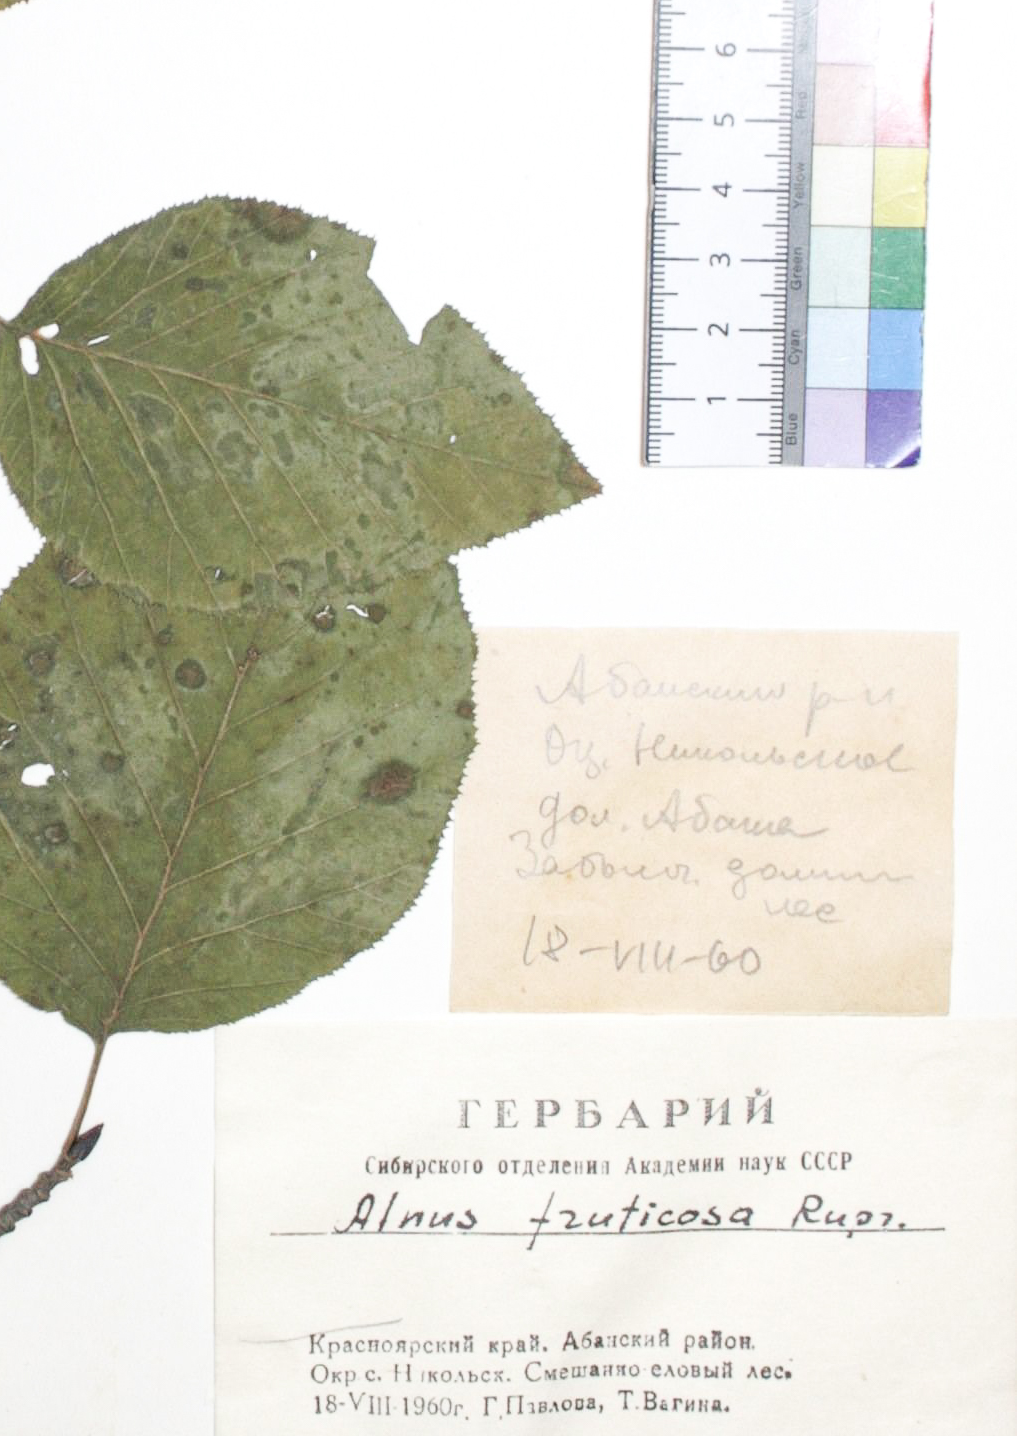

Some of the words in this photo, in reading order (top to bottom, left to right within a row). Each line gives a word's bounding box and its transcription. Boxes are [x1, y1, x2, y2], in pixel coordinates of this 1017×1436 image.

[715, 42, 737, 58] 6
[713, 112, 735, 127] 5
[712, 182, 733, 198] 4
[793, 162, 806, 209] Yellow
[709, 252, 731, 267] 3
[790, 246, 803, 291] Green
[708, 322, 729, 337] 2
[788, 329, 802, 365] Cyan
[706, 396, 726, 405] 1
[785, 412, 798, 446] Blue
[457, 1087, 774, 1129] ГЕРБАРИЙ
[365, 1155, 483, 1179] Сибирского
[498, 1158, 610, 1177] отделения
[625, 1156, 725, 1177] Академии
[739, 1154, 787, 1175] наук
[801, 1151, 853, 1171] СССР
[334, 1191, 478, 1234] Alnus
[526, 1191, 754, 1250] fruticosa
[309, 1333, 474, 1359] Красноярский
[488, 1334, 548, 1358] край.
[562, 1329, 670, 1351] Абанский
[684, 1330, 756, 1353] район.
[747, 1365, 792, 1380] лес.
